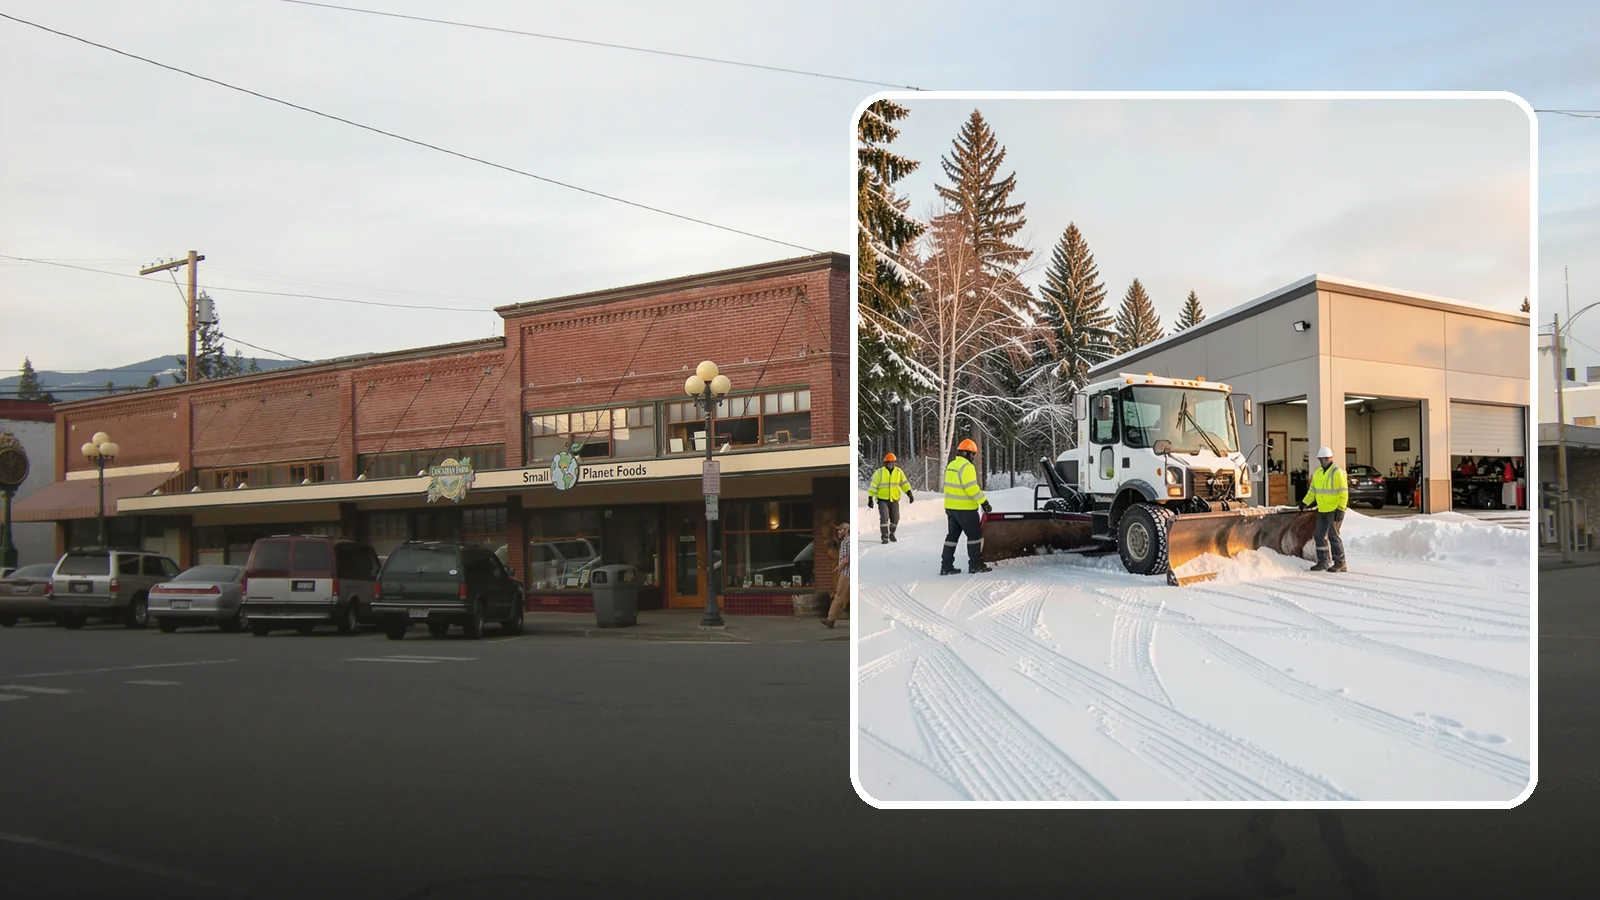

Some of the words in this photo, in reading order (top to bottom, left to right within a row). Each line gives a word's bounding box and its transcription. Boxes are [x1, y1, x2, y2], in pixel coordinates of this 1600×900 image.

[523, 470, 549, 482] Small
[583, 467, 614, 479] Planet
[617, 464, 647, 477] Foods
